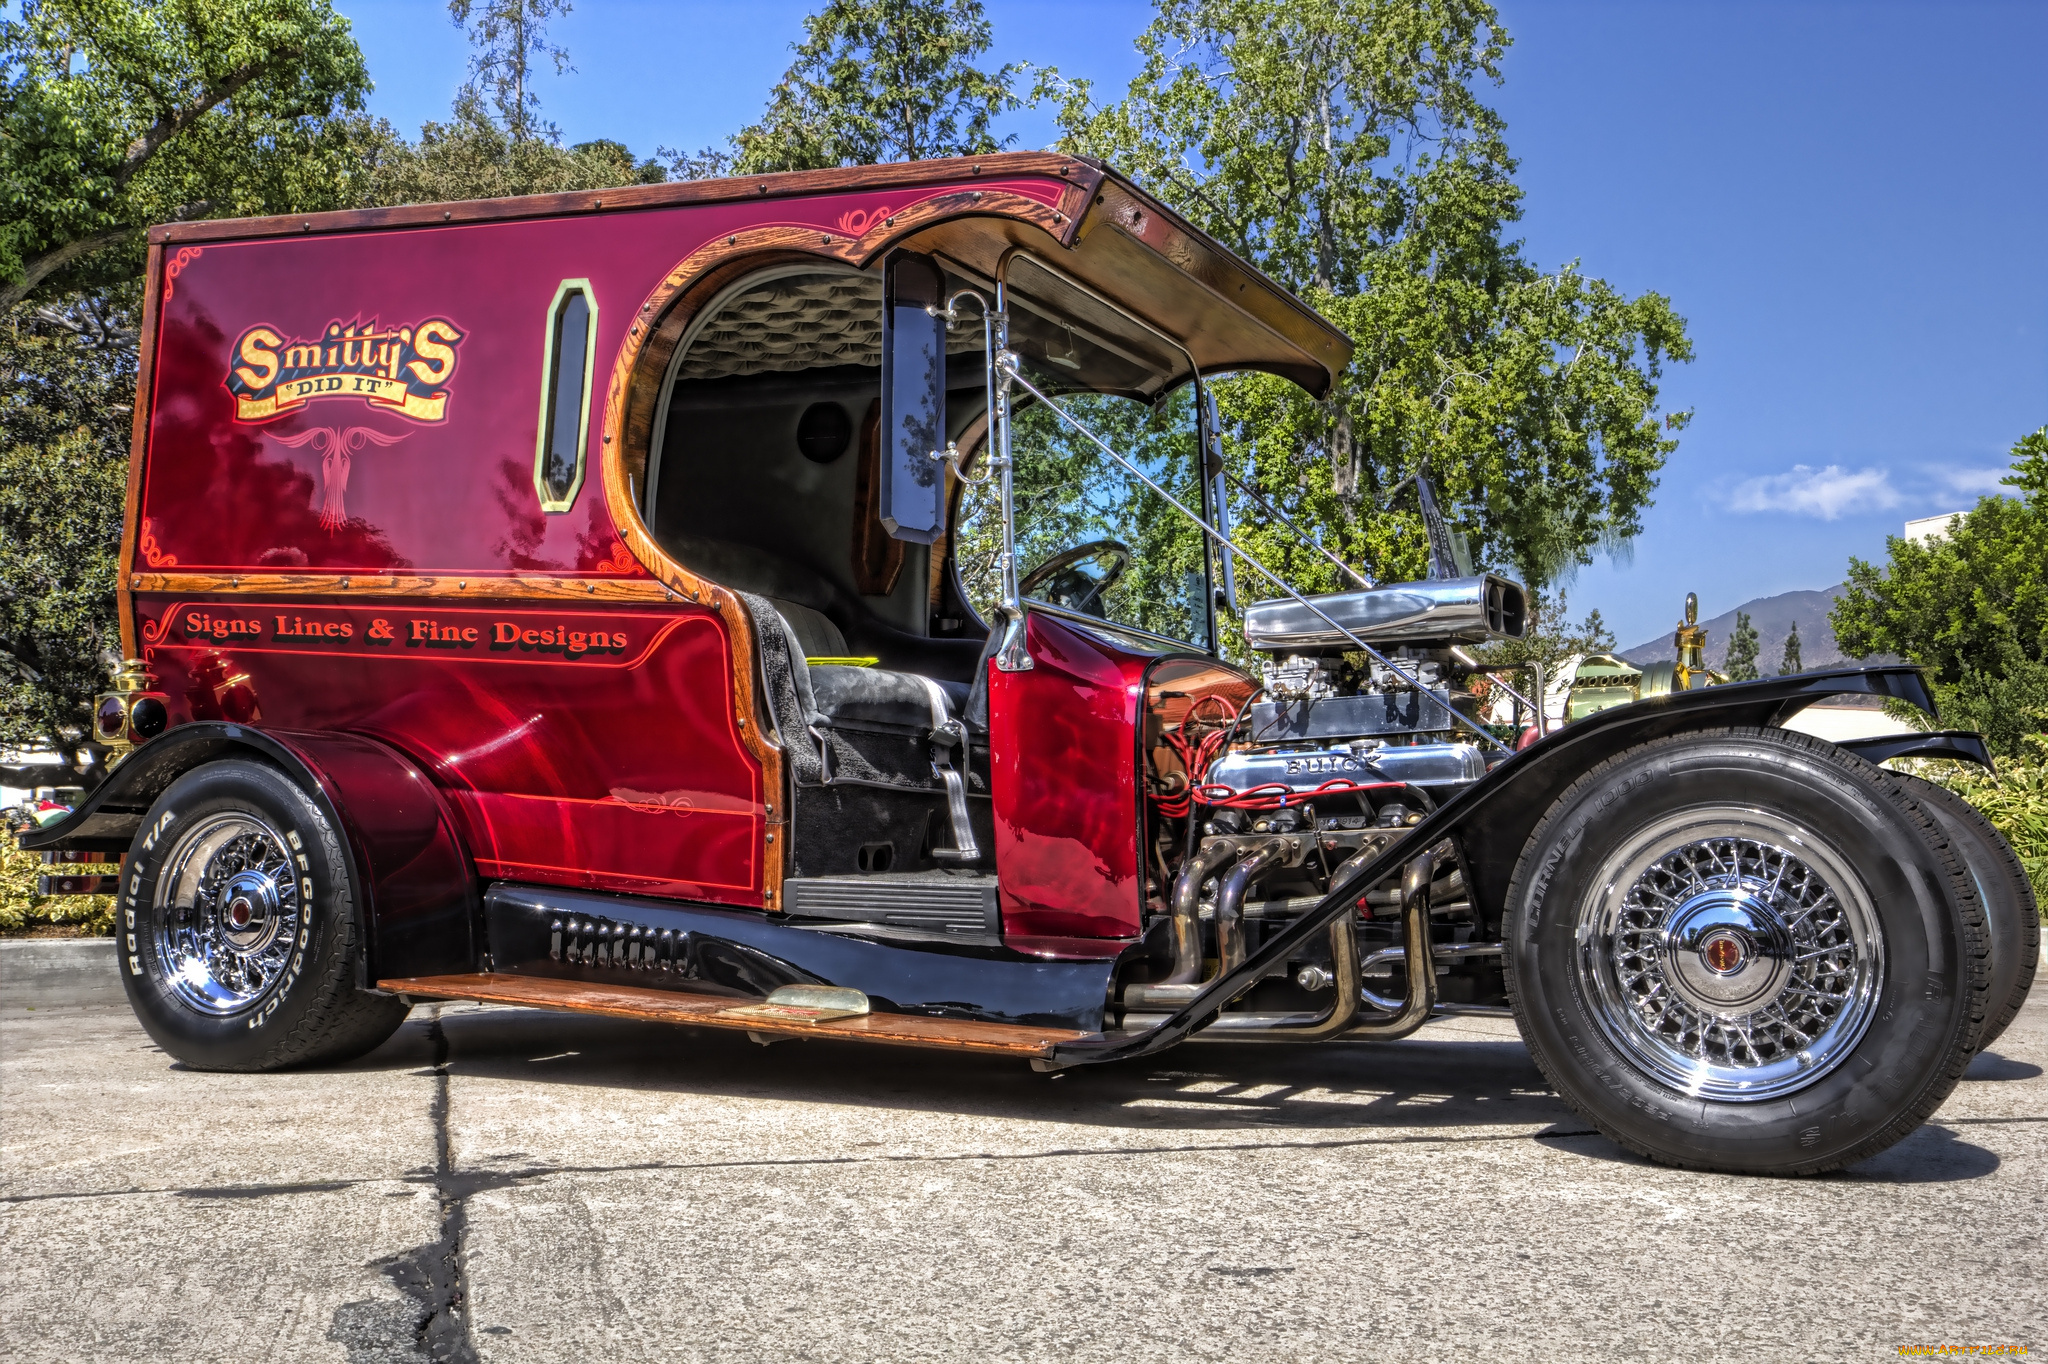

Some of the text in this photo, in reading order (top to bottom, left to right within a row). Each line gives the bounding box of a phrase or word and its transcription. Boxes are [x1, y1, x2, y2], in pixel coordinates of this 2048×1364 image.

[186, 612, 628, 652] Signs Lines & Fine Designs
[1286, 754, 1383, 776] BUICK
[126, 809, 177, 977] Radial T/A
[1528, 813, 1593, 928] CORNELL
[1594, 768, 1654, 813] 1000
[249, 830, 314, 1030] BFGoodrich
[1869, 976, 1944, 1102] RADIAL
